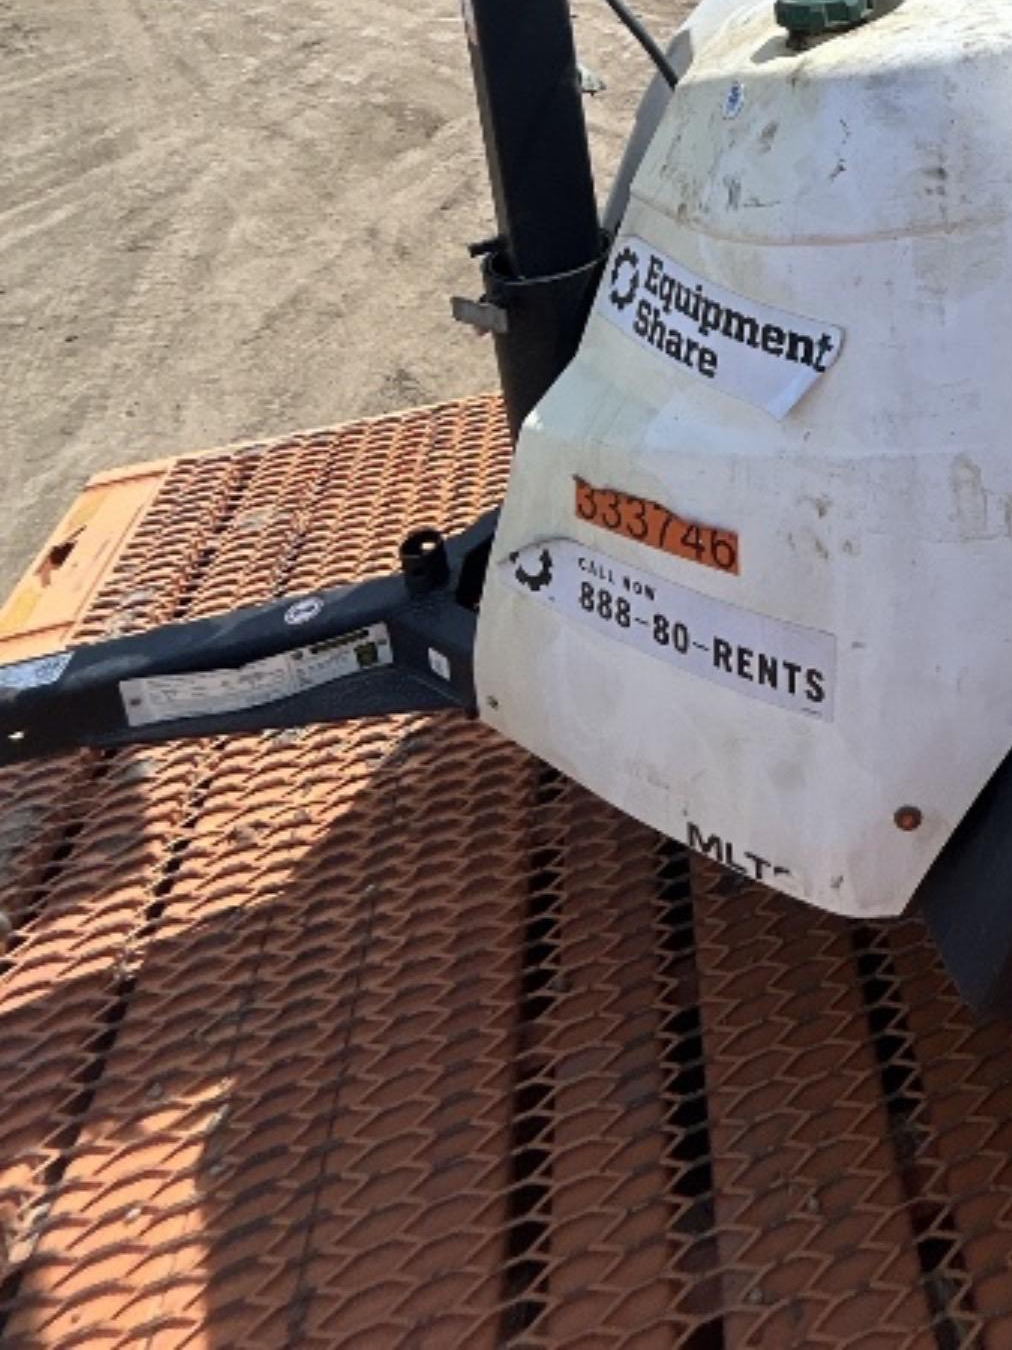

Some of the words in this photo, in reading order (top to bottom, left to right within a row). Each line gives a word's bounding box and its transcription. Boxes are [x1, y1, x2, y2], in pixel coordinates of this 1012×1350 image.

[633, 298, 718, 378] Share
[643, 253, 834, 373] Equipment
[575, 482, 737, 570] 333746
[577, 557, 615, 584] CALL
[621, 573, 656, 601] NOW
[577, 580, 826, 703] 888-80-RENTS
[687, 821, 791, 880] MLT
